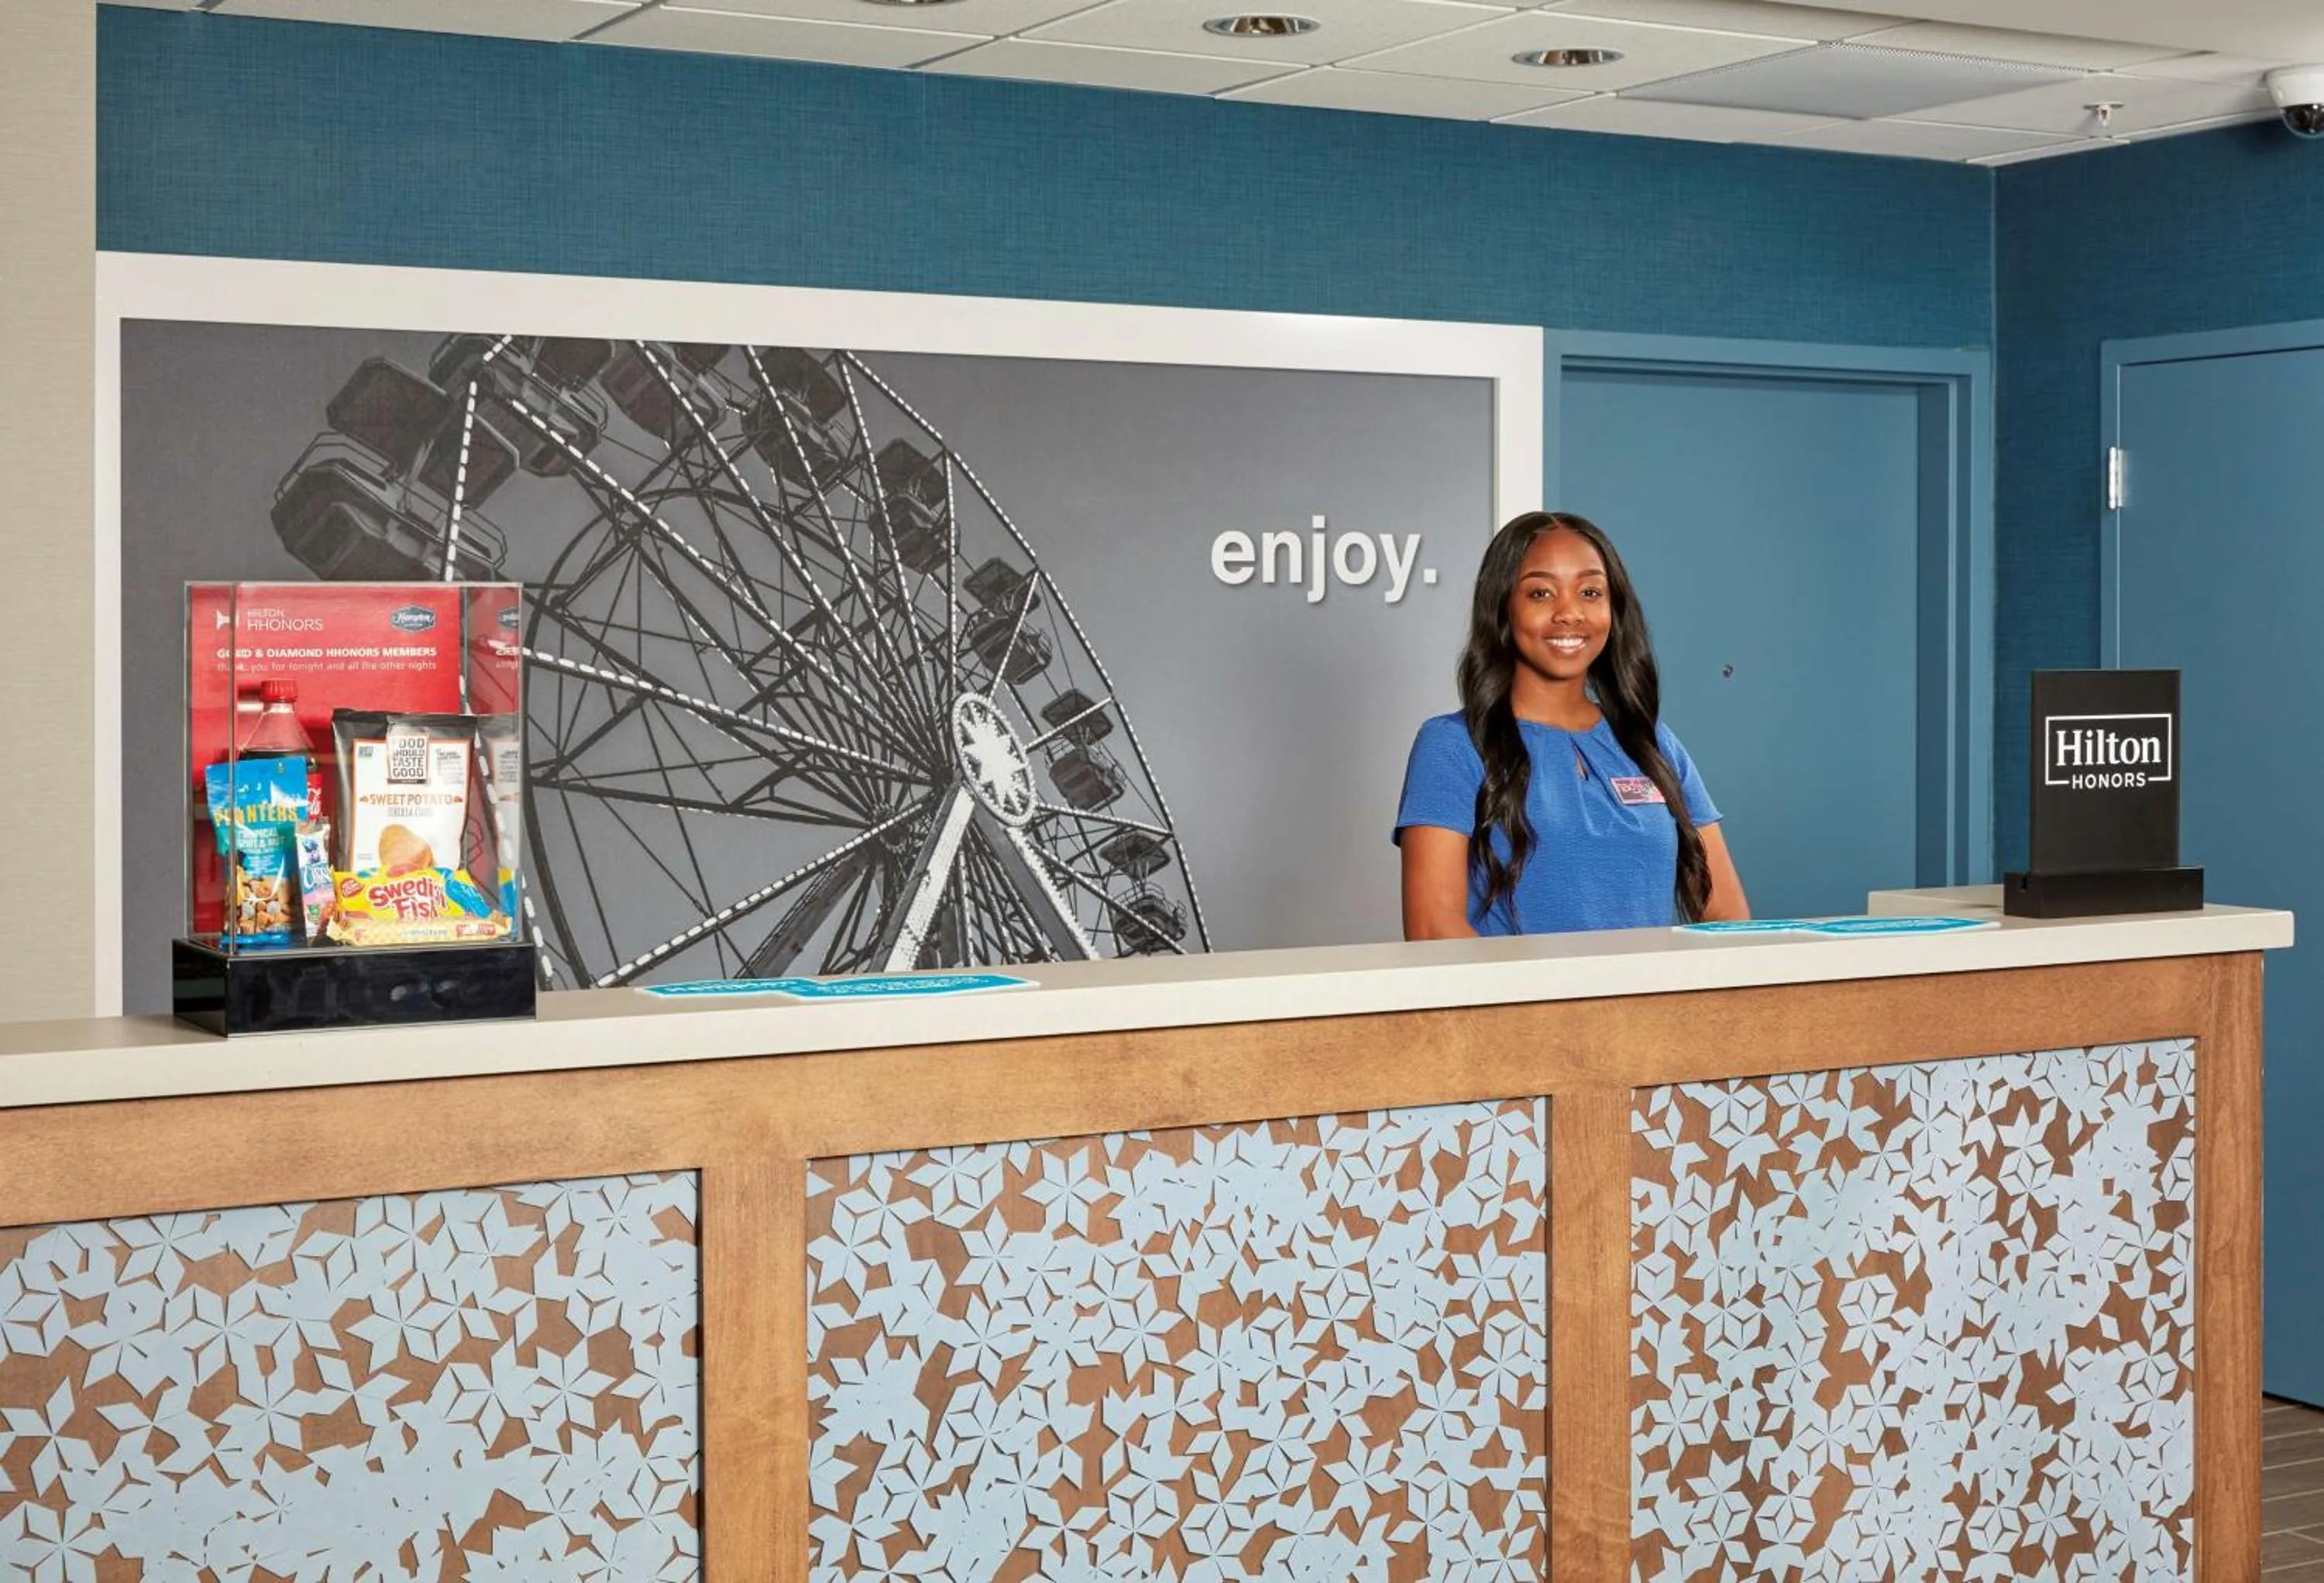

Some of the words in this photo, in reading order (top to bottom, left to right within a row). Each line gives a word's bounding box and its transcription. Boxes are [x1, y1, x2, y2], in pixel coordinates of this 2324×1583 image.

[1211, 515, 1437, 603] enjoy.
[247, 619, 323, 631] HHONORS
[255, 648, 263, 657] &
[266, 648, 323, 658] DIAMOND
[326, 647, 380, 657] HHONORS
[382, 647, 436, 657] MEMBERS
[272, 661, 285, 670] for
[362, 661, 377, 669] the
[408, 661, 436, 671] nights
[392, 738, 425, 749] OOD
[2055, 730, 2161, 766] Hilton
[393, 757, 424, 767] TASTE
[393, 767, 424, 778] GOOD
[2072, 773, 2146, 789] HONORS
[370, 794, 404, 805] SWEET
[407, 794, 452, 805] POTATO
